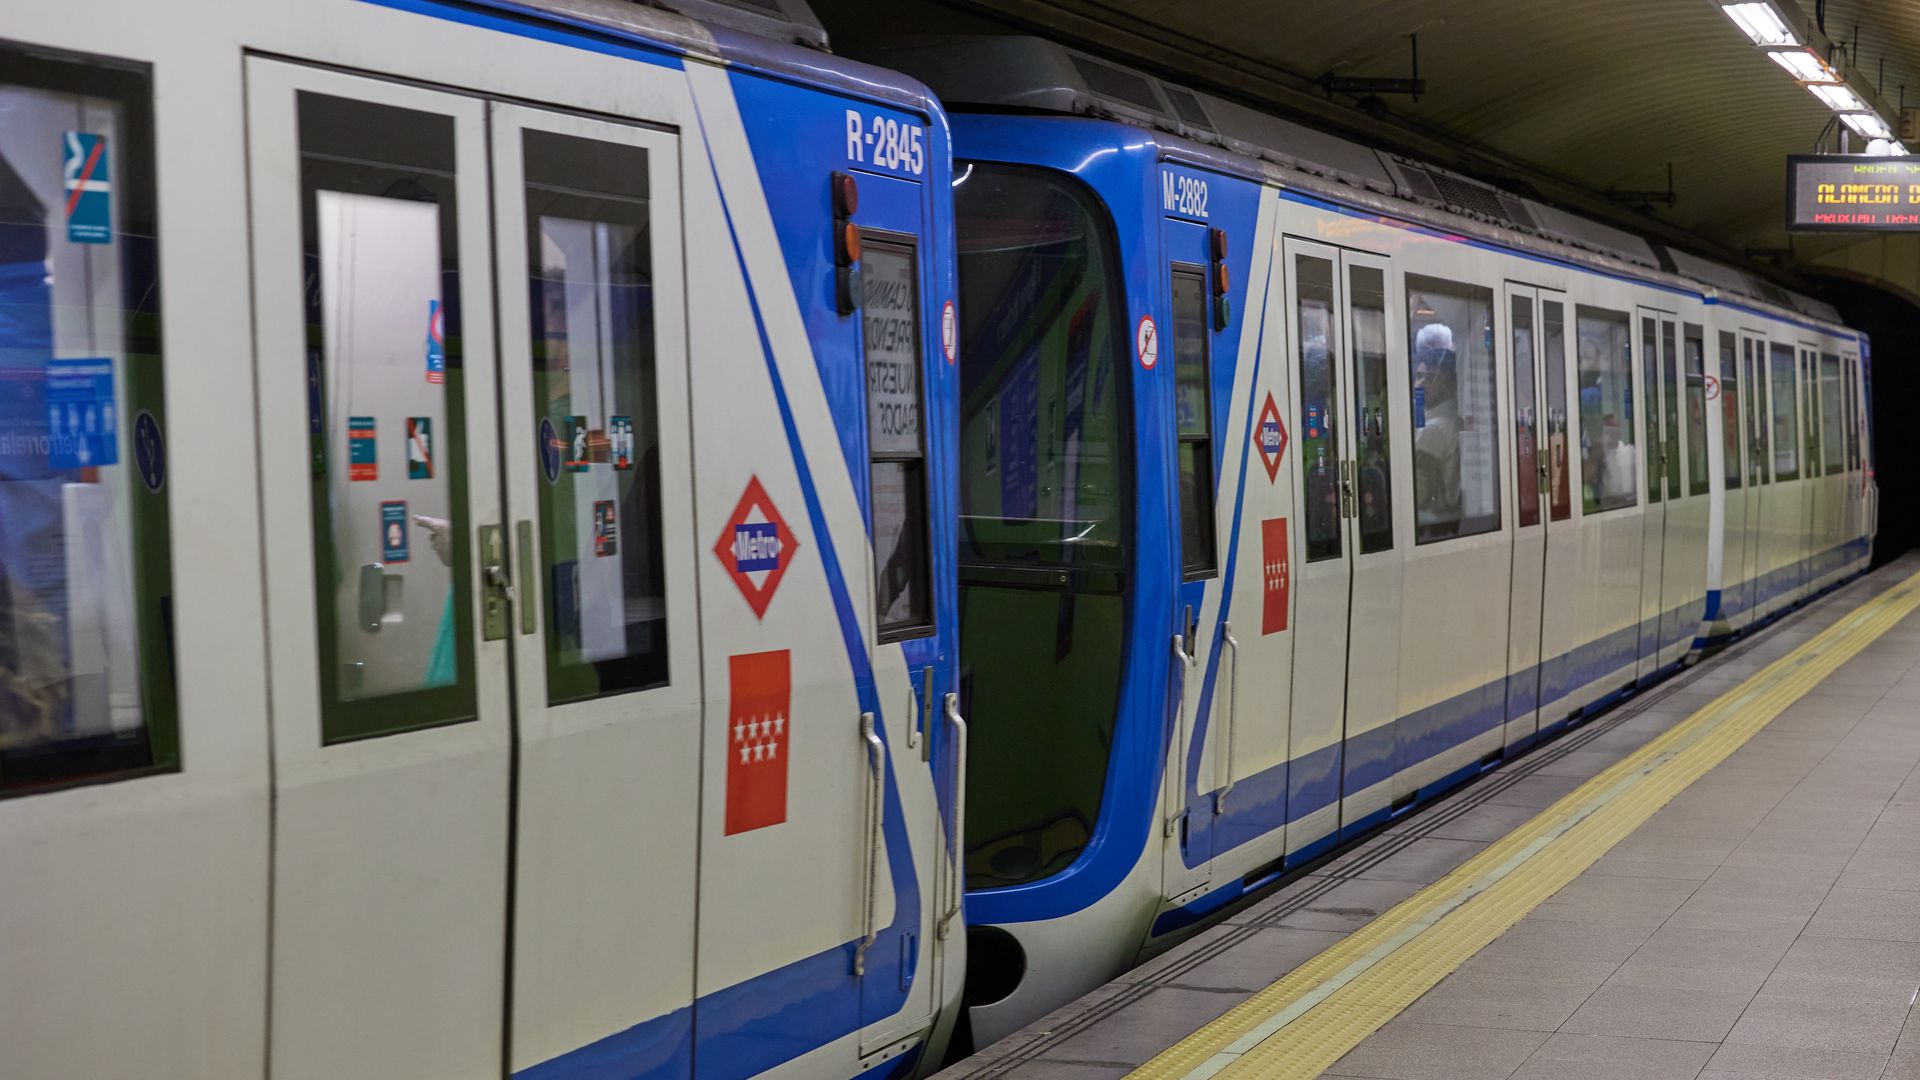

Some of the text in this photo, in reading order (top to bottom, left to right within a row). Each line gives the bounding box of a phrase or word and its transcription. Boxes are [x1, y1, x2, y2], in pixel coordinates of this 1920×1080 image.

[846, 109, 924, 175] R-2845
[1163, 170, 1209, 218] M-2882
[1263, 427, 1280, 446] Metro
[736, 530, 777, 561] Metro
